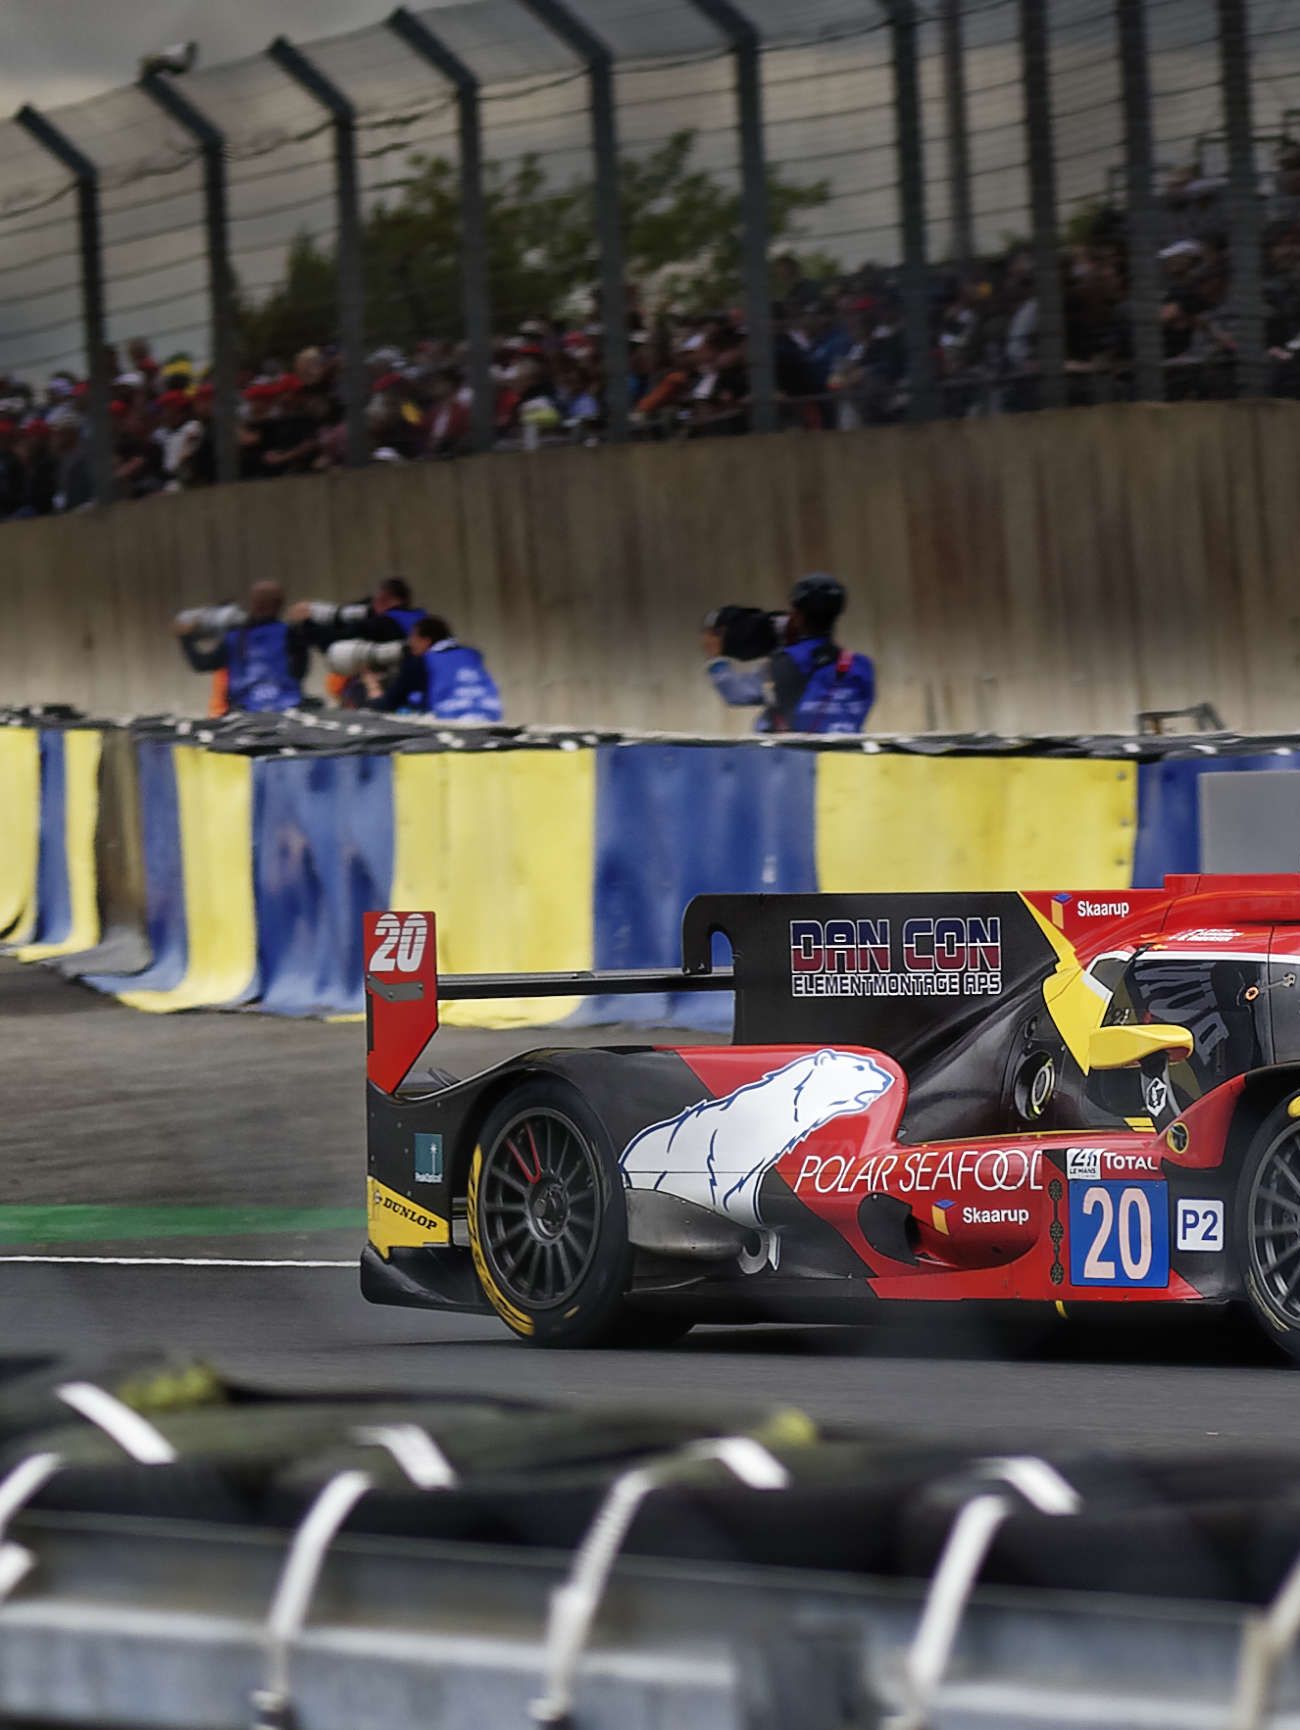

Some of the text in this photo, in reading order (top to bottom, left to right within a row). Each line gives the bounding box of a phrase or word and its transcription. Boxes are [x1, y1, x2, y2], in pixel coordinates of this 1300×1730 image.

[1077, 900, 1129, 918] Skaarup
[369, 913, 428, 972] 20
[790, 917, 1002, 974] DAN CON
[791, 972, 1002, 997] ELEMENTMONTAGE APS
[793, 1155, 898, 1193] POLAR
[1103, 1152, 1159, 1170] TOTAL
[383, 1197, 438, 1230] DUNLOP
[962, 1207, 1030, 1224] Skaarup
[1182, 1209, 1219, 1241] P2
[1082, 1187, 1153, 1280] 20
